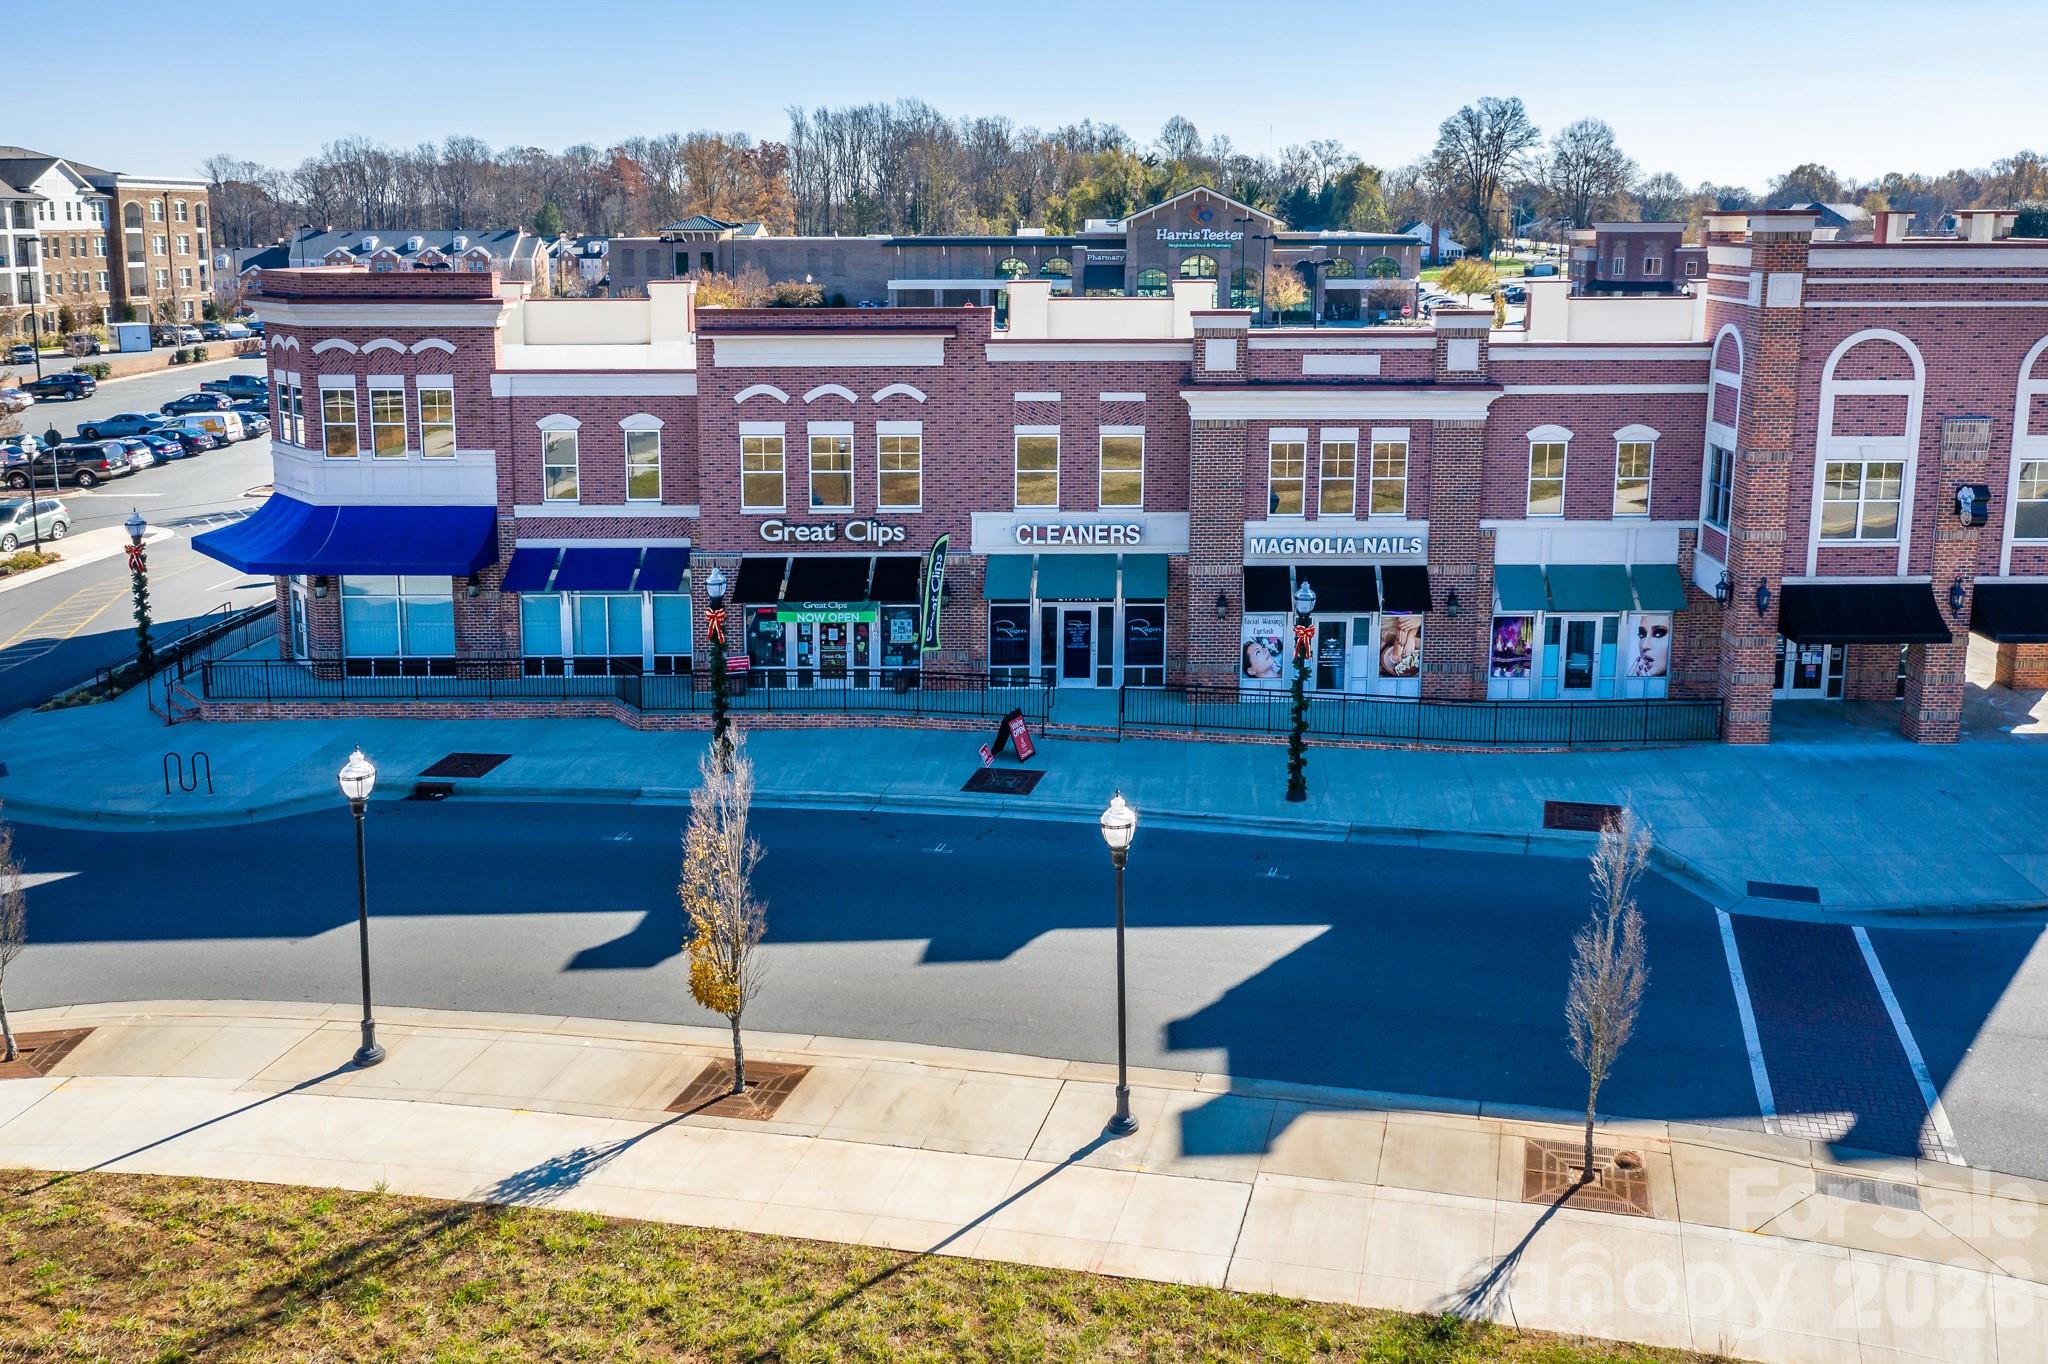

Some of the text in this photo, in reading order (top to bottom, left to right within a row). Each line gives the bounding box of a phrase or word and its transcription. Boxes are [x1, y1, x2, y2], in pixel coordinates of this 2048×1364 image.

[1156, 228, 1244, 240] Harris Teeter
[1087, 254, 1125, 262] Pharmacy
[760, 520, 905, 547] Great Clips
[1016, 524, 1140, 545] CLEANERS
[1250, 538, 1423, 554] MAGNOLIA NAILS
[931, 554, 944, 593] Clips
[803, 601, 848, 610] Great Clips
[797, 613, 859, 622] NOW OPEN
[1013, 726, 1026, 737] OPEN
